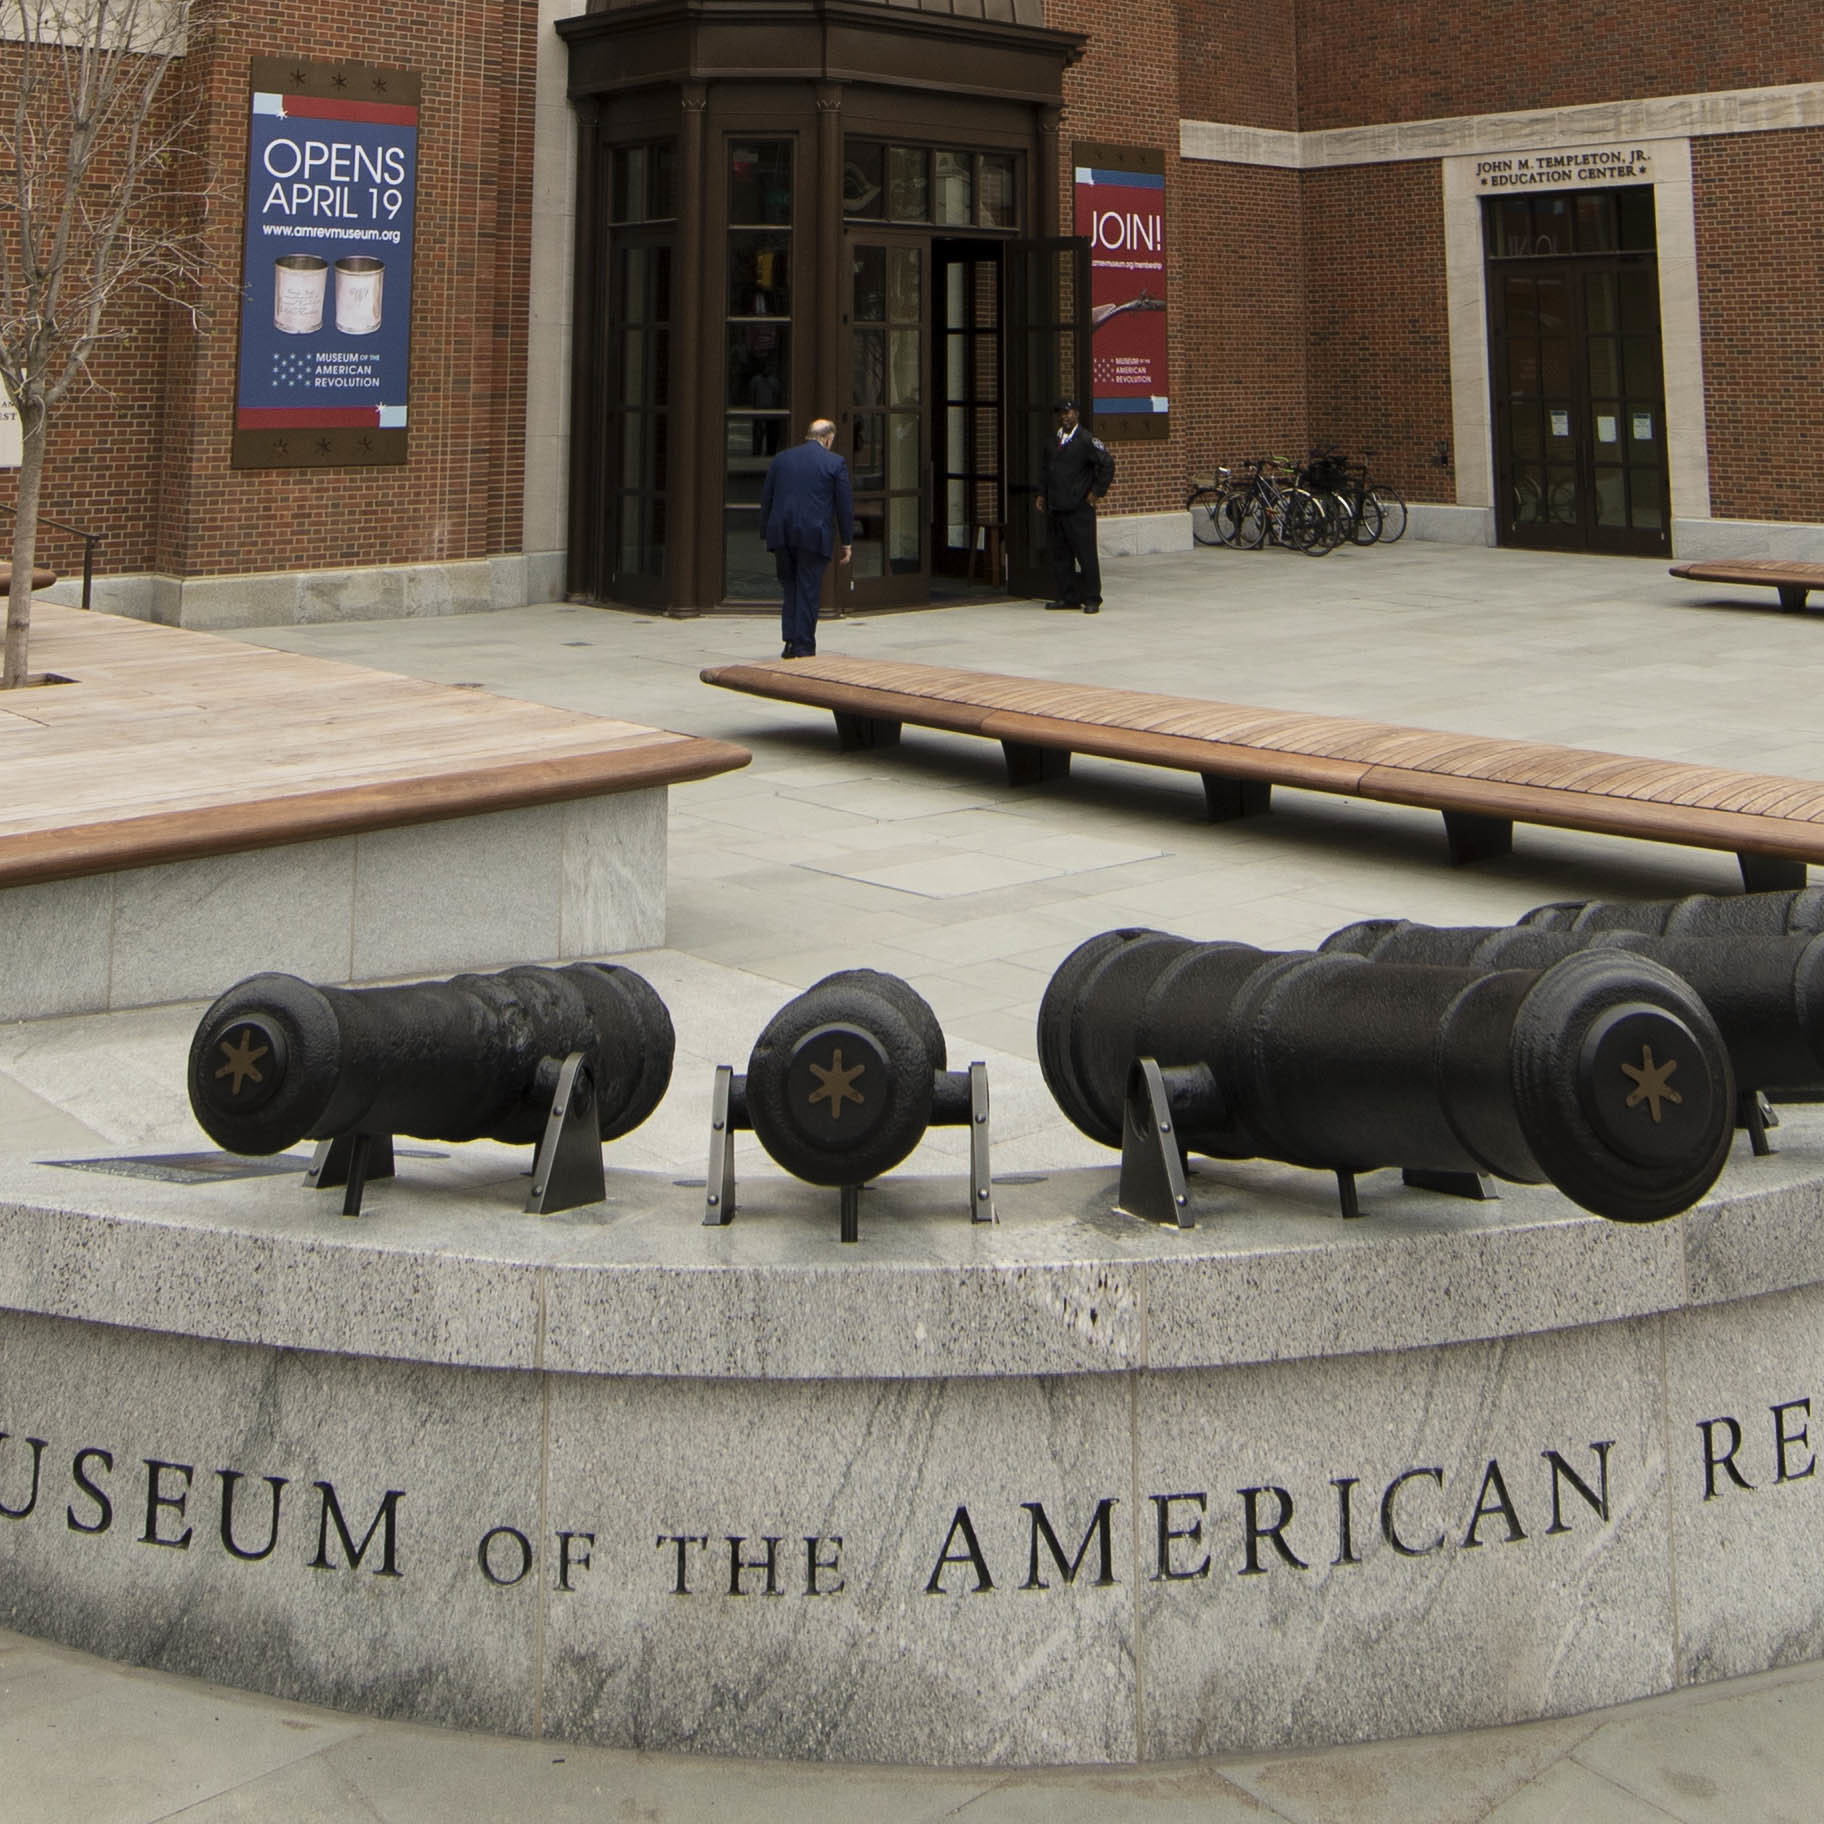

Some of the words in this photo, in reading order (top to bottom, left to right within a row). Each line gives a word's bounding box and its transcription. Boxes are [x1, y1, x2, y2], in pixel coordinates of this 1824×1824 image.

[263, 138, 405, 186] OPENS
[1476, 159, 1513, 176] JOHN
[1518, 160, 1534, 170] M.
[1628, 150, 1651, 164] JR.
[1491, 169, 1572, 187] EDUCATION
[1577, 166, 1635, 181] CENTER
[262, 182, 358, 219] APRIL
[369, 187, 403, 220] 19
[262, 223, 401, 243] www.amrevmuseum.org
[1091, 210, 1162, 251] JOIN!
[316, 353, 359, 363] MUSEUM
[314, 365, 372, 375] AMERICAN
[314, 377, 380, 387] REVOLUTION
[1, 400, 16, 408] AN
[476, 1526, 598, 1588] OF
[656, 1534, 847, 1597] THE
[924, 1440, 1619, 1596] AMERICAN
